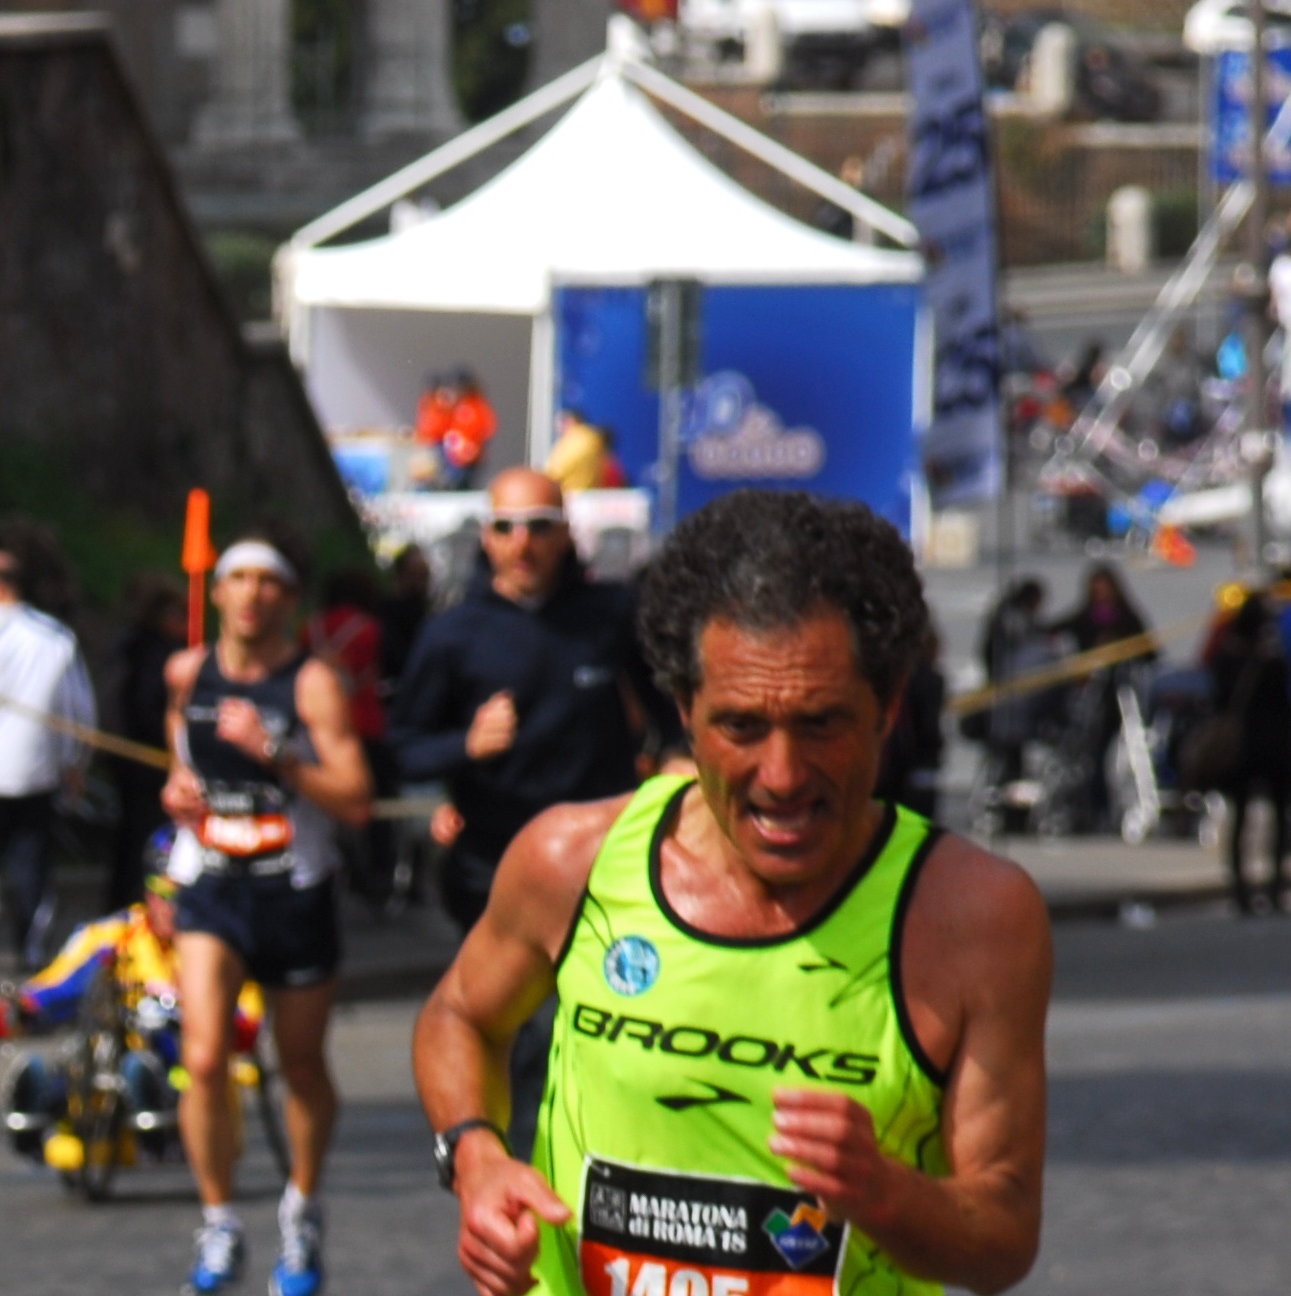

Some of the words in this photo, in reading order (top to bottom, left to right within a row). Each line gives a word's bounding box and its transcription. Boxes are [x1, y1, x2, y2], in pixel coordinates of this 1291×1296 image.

[573, 1003, 880, 1085] BROOKS
[629, 1192, 747, 1230] MARATONA
[652, 1219, 717, 1249] ROMA
